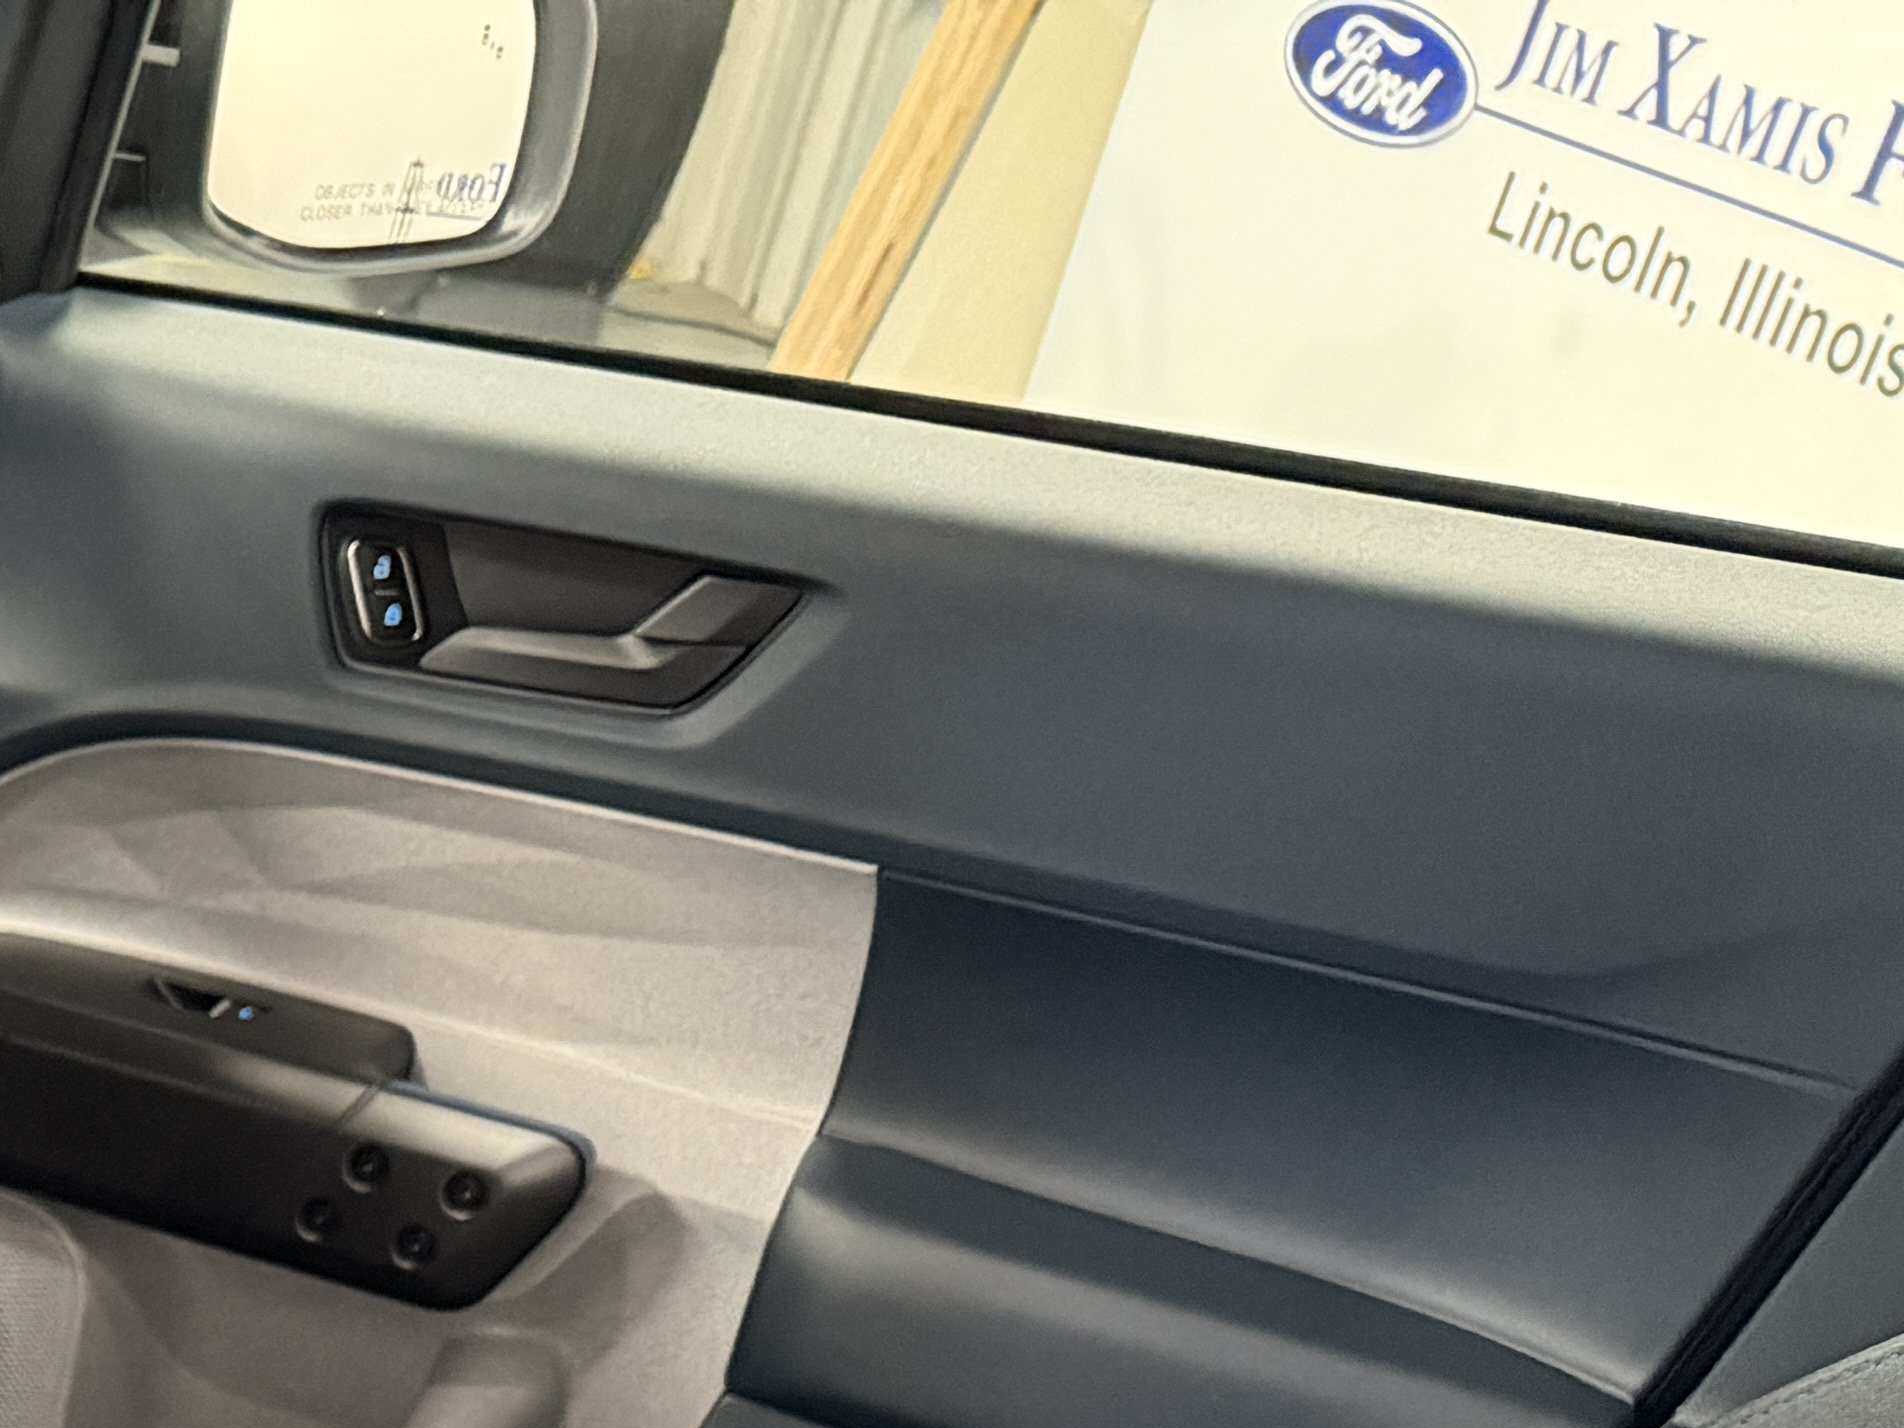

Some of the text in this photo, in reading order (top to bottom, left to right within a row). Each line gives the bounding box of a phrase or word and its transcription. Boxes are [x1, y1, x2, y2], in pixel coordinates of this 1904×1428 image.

[1311, 12, 1445, 132] Ford
[1496, 0, 1619, 107] JIM
[1619, 23, 1852, 186] XAMIS
[1486, 170, 1699, 330] Lincoln,
